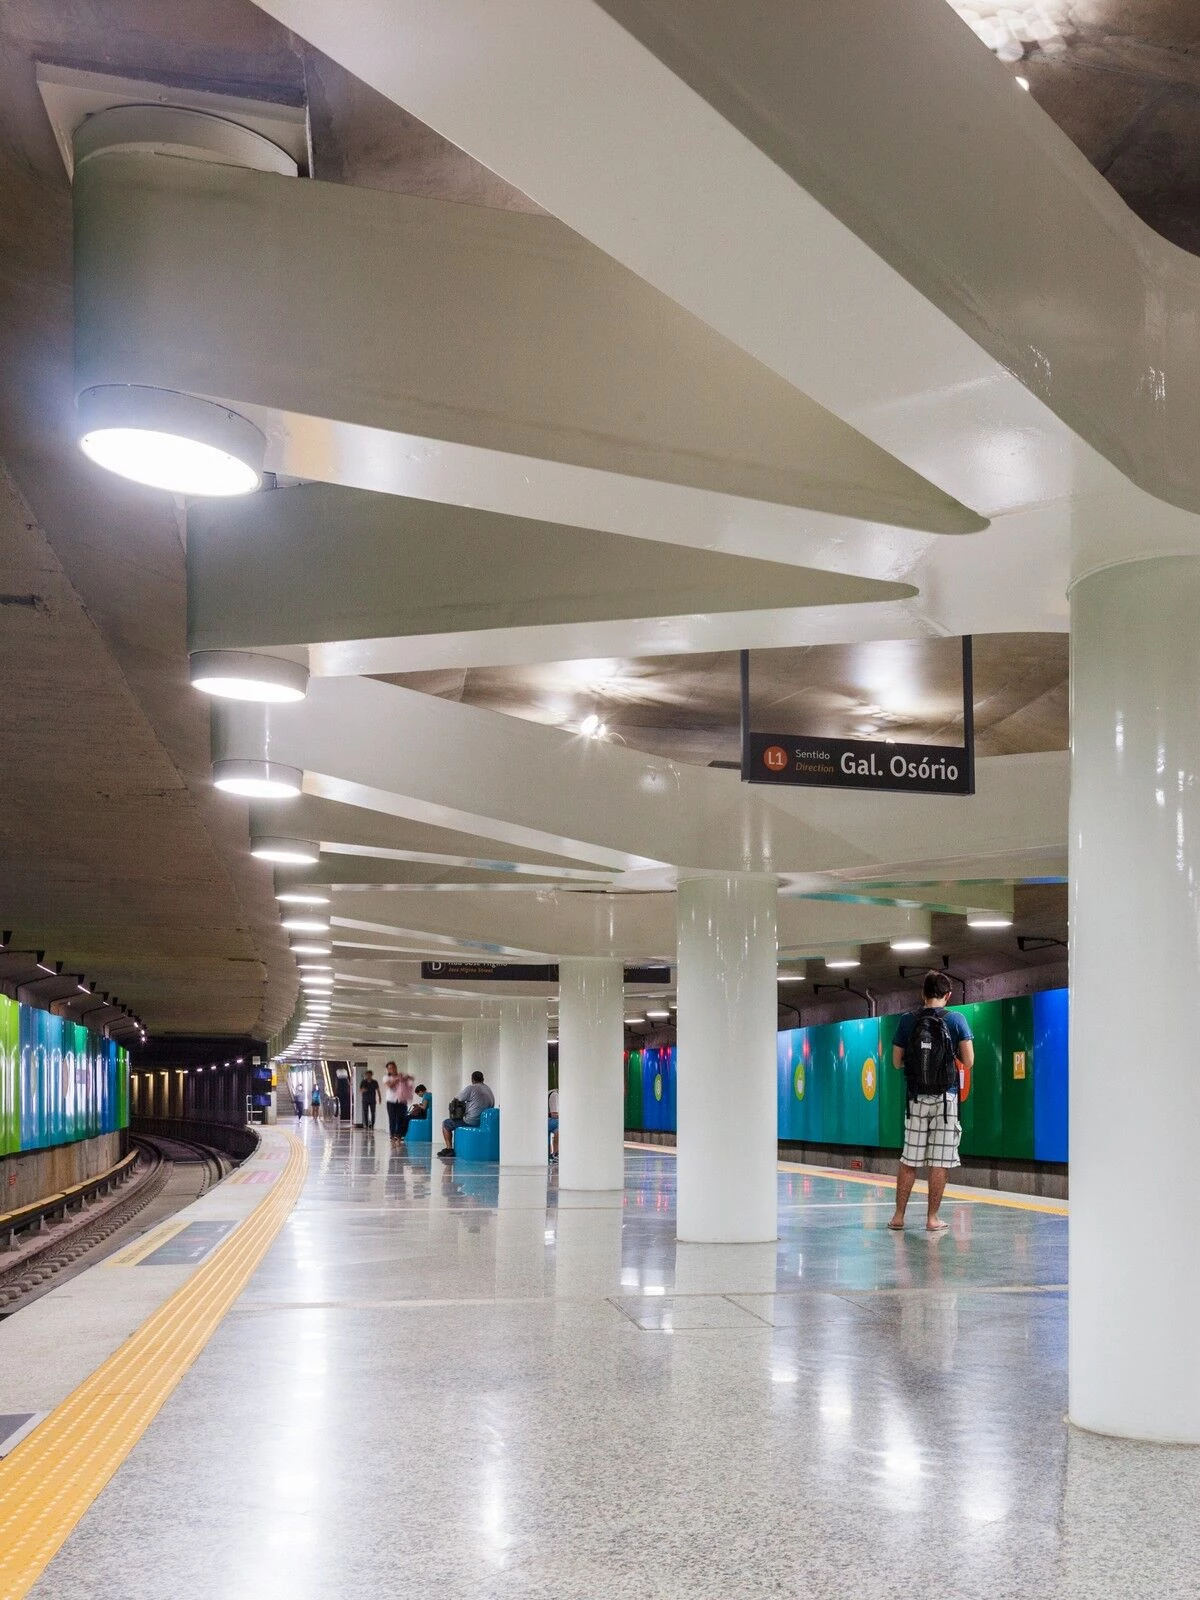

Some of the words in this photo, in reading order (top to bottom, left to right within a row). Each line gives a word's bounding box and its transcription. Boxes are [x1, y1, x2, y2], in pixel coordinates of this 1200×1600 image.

[768, 751, 784, 766] L1
[795, 749, 831, 760] Sentido
[795, 762, 834, 773] Direction
[840, 752, 884, 776] Gal.
[889, 754, 959, 781] Osório
